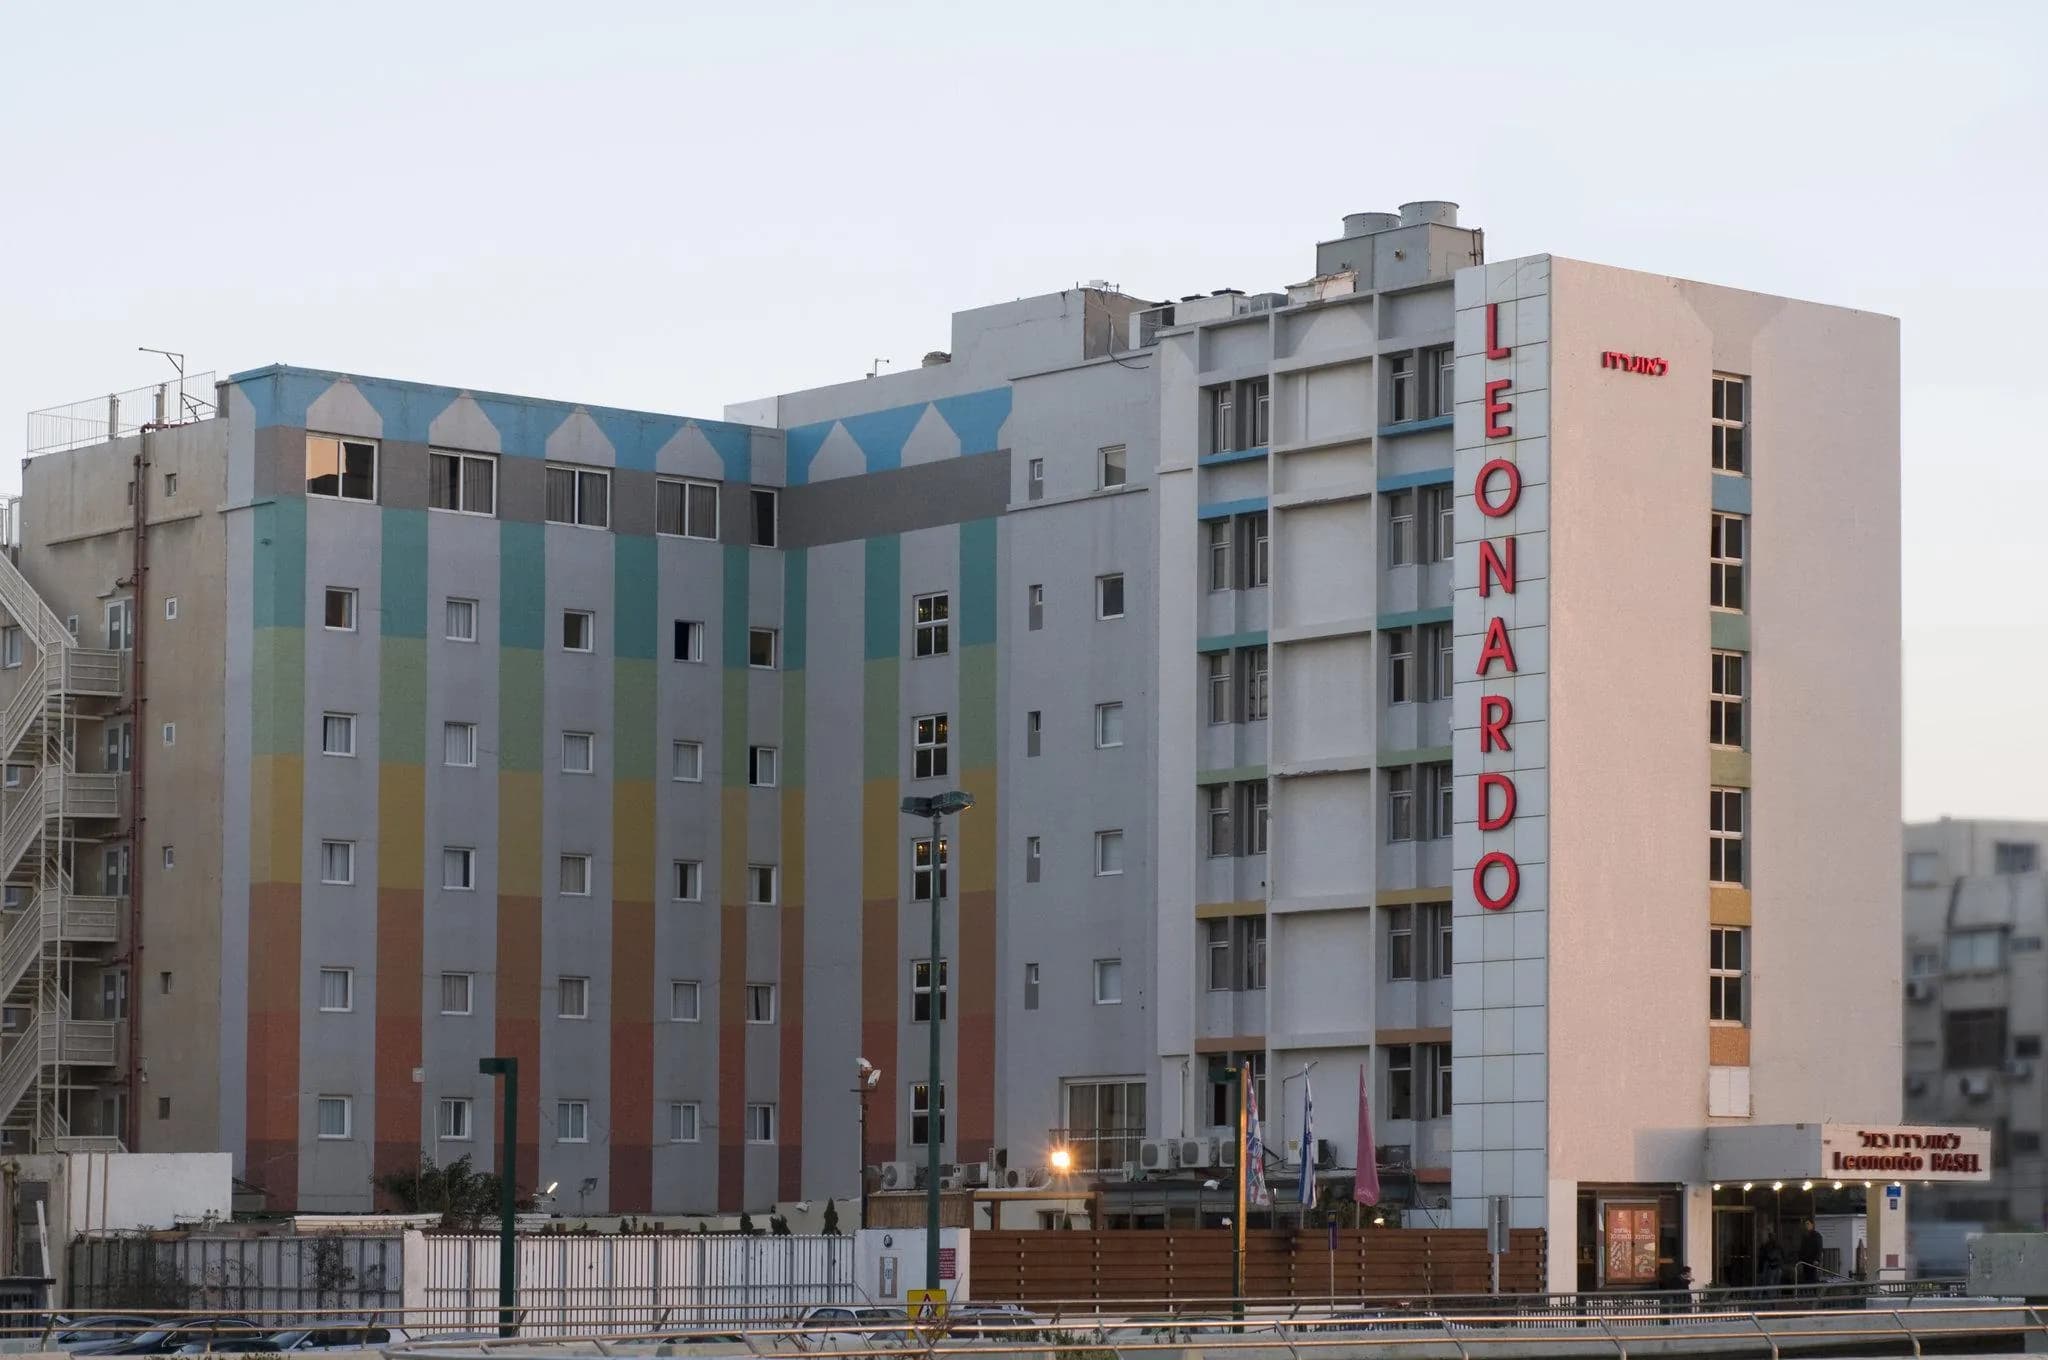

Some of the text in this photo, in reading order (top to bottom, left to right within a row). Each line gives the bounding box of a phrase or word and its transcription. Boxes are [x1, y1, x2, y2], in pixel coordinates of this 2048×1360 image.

[1602, 351, 1669, 376] לאונרדו
[1473, 302, 1521, 913] LEONARDO
[1894, 1132, 1961, 1150] לאונרדו
[1832, 1151, 1982, 1173] Leonardo BASEL
